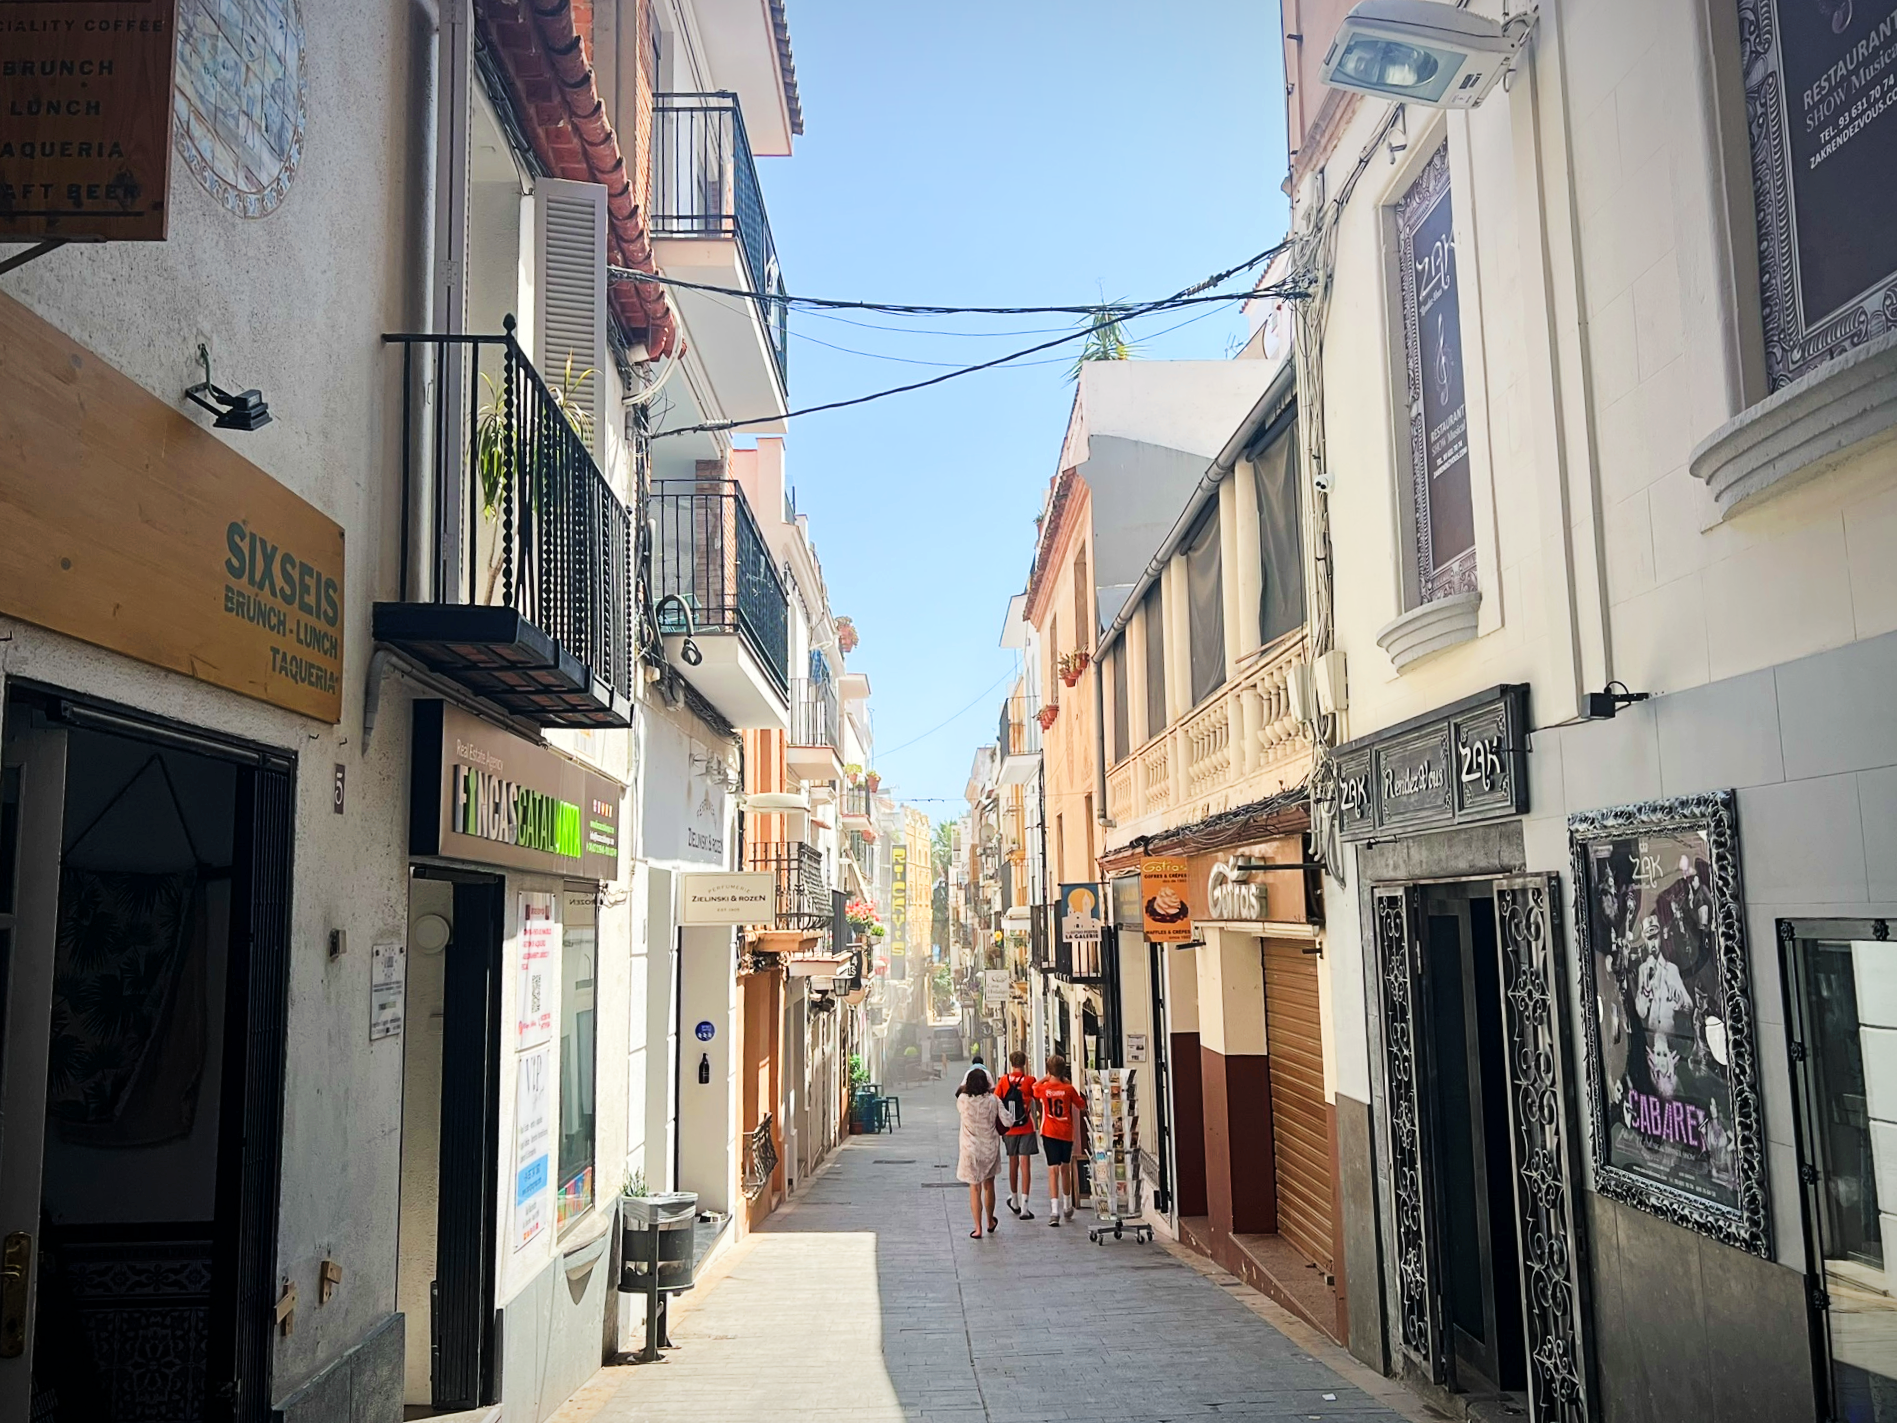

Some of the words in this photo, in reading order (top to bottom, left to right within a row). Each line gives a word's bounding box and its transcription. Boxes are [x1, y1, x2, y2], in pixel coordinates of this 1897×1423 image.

[84, 20, 163, 32] COFFEE
[3, 60, 114, 76] BRUNCH
[1803, 8, 1897, 111] RESTAURANT
[10, 99, 102, 116] LUNCH
[1806, 82, 1848, 133] SHOW
[1819, 125, 1837, 144] TEL.
[1838, 112, 1849, 129] 93
[1851, 97, 1868, 119] 631
[1869, 85, 1881, 103] 70
[1883, 73, 1895, 91] 74
[1430, 403, 1465, 444] RESTAURANT
[225, 521, 339, 628] SIXSEIS
[224, 584, 287, 637] BRUNCH
[296, 619, 338, 660] LUNCH
[270, 645, 337, 695] TAQUERIA
[1459, 736, 1500, 791] ZAK
[1339, 774, 1367, 818] ZAK
[1629, 854, 1664, 888] ZAK
[1048, 1098, 1064, 1117] 16
[1629, 1089, 1706, 1151] CABARET
